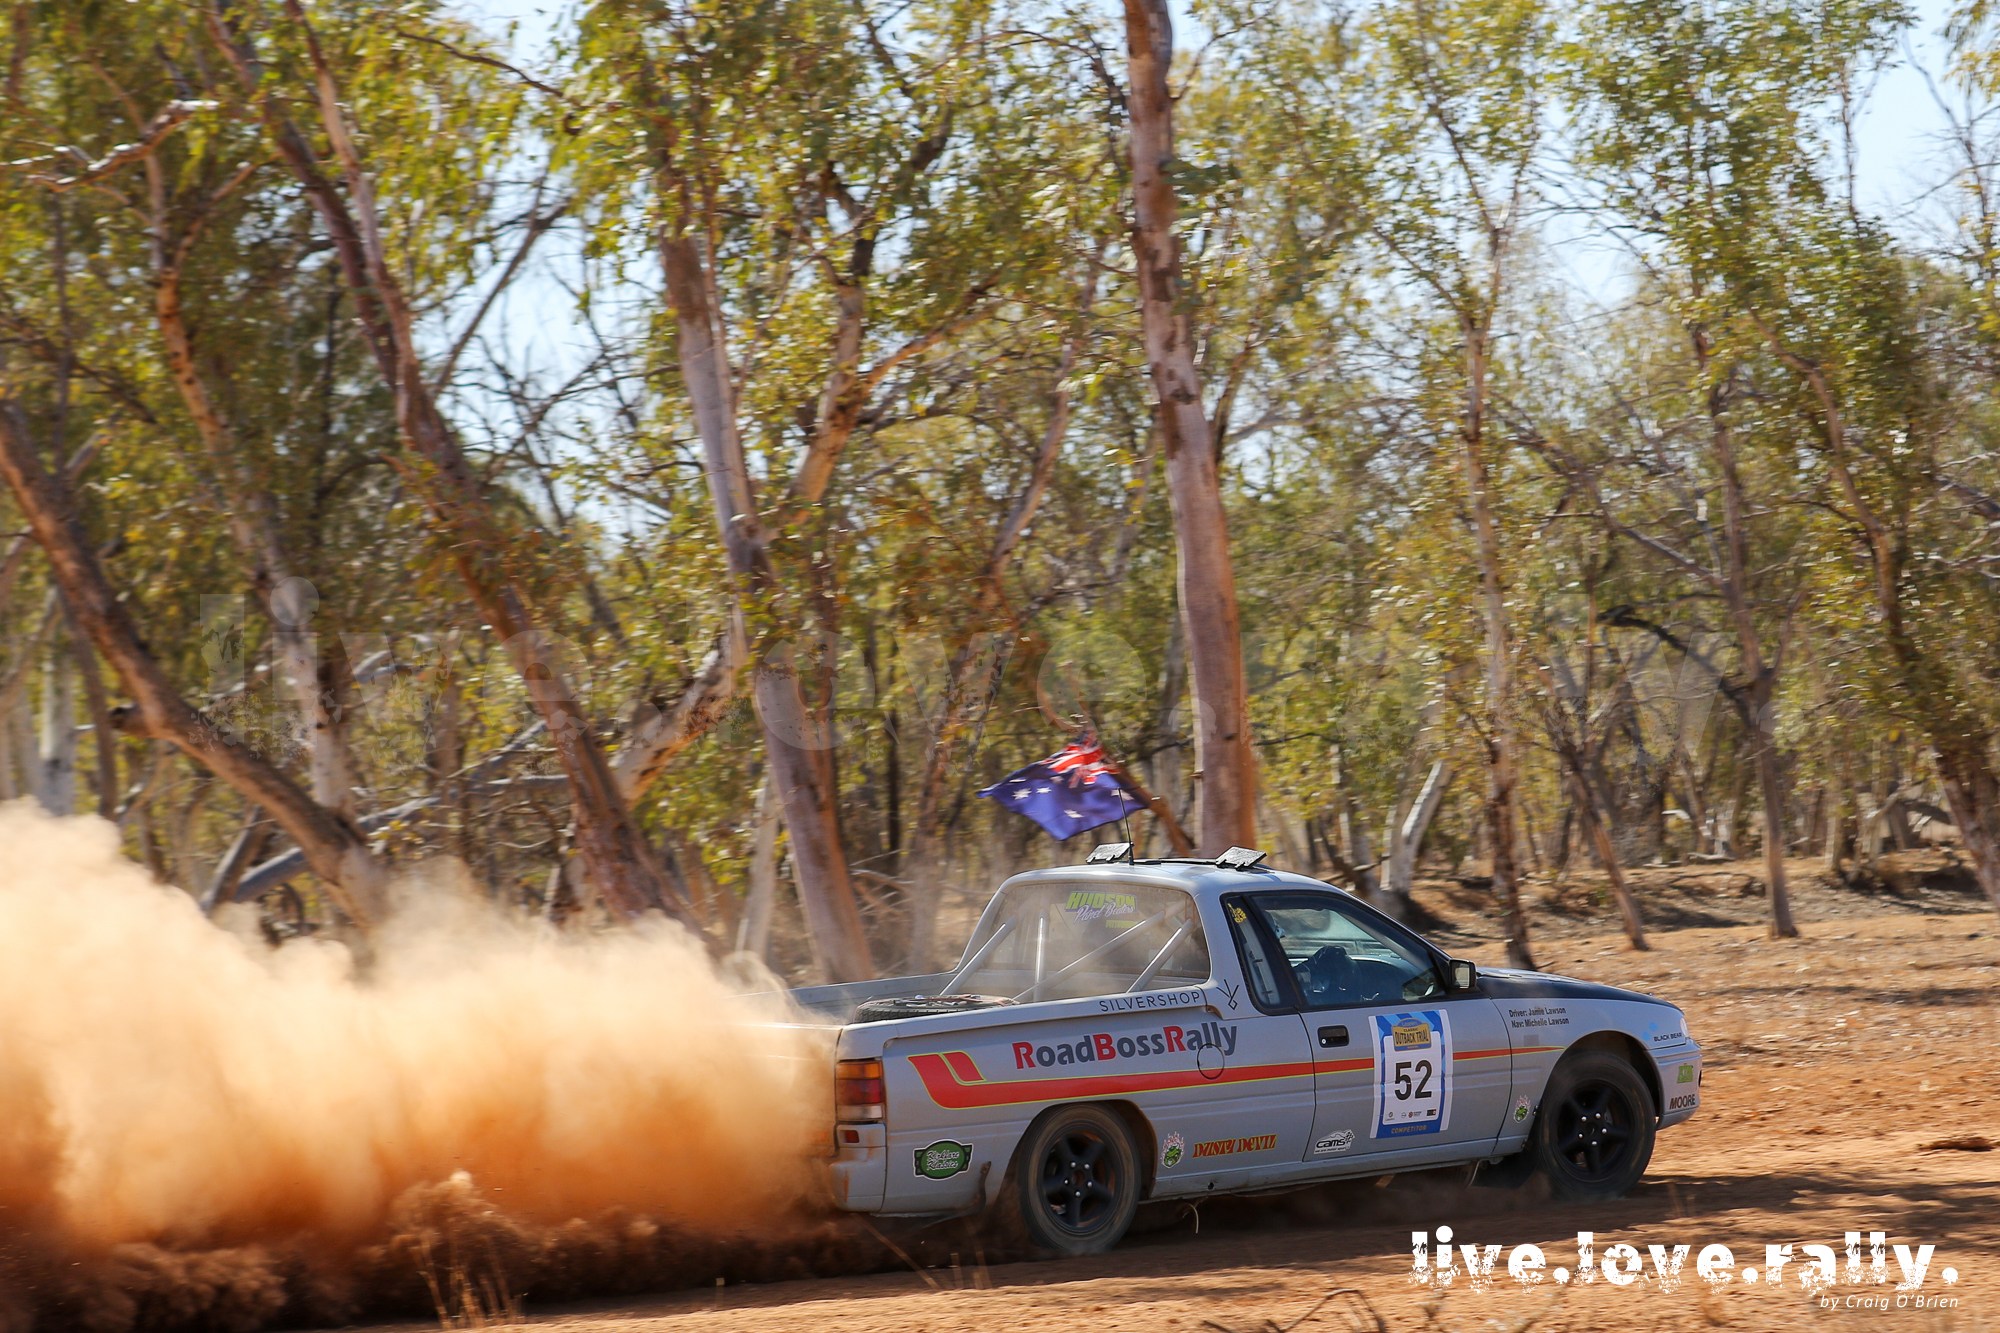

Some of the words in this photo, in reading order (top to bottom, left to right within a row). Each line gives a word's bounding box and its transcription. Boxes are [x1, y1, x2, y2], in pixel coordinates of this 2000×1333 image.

[1066, 892, 1135, 910] HUDSON
[1099, 991, 1200, 1012] SILVERSHOP
[1508, 1008, 1528, 1018] Driver:
[1545, 1006, 1567, 1015] Lawson
[1511, 1019, 1525, 1028] Nav:
[1524, 1018, 1548, 1027] Michelle
[1547, 1017, 1570, 1026] Lawson
[1012, 1021, 1238, 1070] RoadBossRally
[1395, 1032, 1415, 1045] OUTBACK
[1416, 1029, 1429, 1043] TRIAL
[1653, 1034, 1670, 1042] BLACK
[1670, 1032, 1683, 1040] BEAR
[1394, 1059, 1433, 1101] 52
[1669, 1093, 1696, 1110] MOORE
[1390, 1125, 1428, 1134] COMPETITOR
[1237, 1134, 1278, 1152] DEVIL
